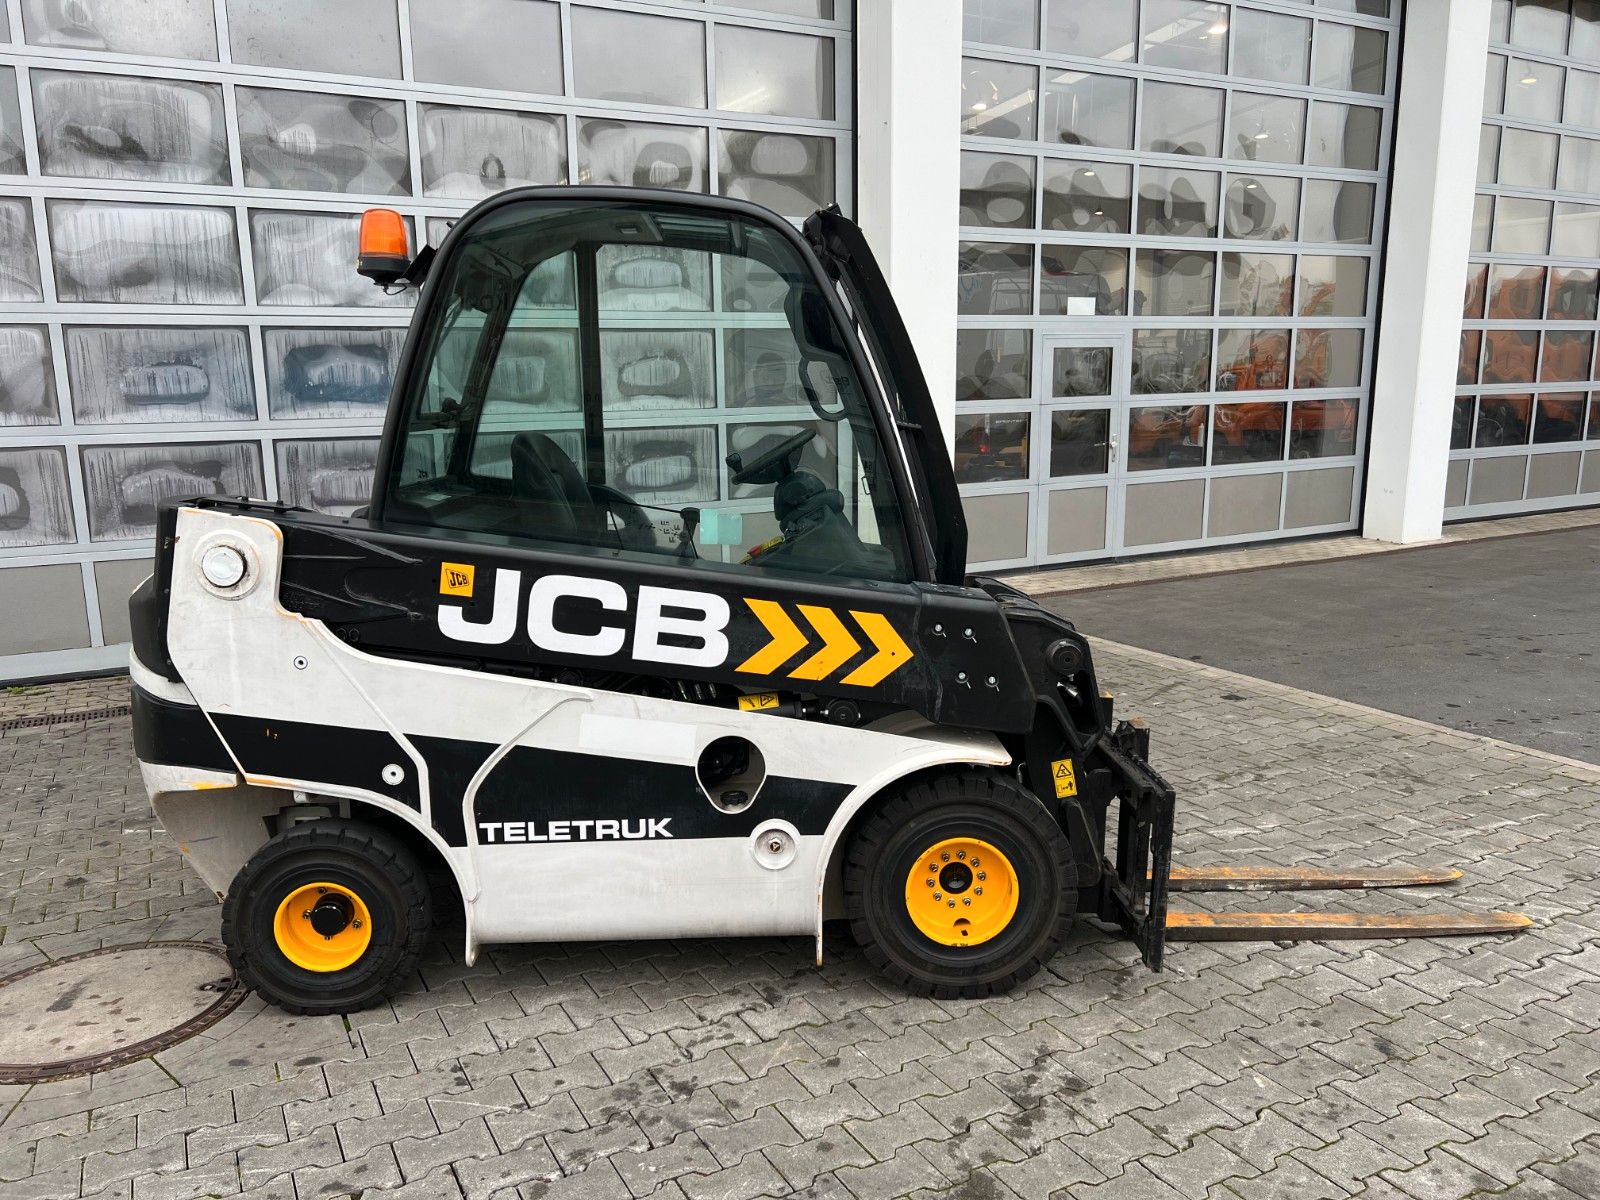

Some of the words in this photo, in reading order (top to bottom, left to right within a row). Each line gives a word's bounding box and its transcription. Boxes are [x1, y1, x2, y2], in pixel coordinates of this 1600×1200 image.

[450, 571, 468, 587] JCB
[438, 568, 731, 668] JCB
[479, 818, 674, 842] TELETRUK
